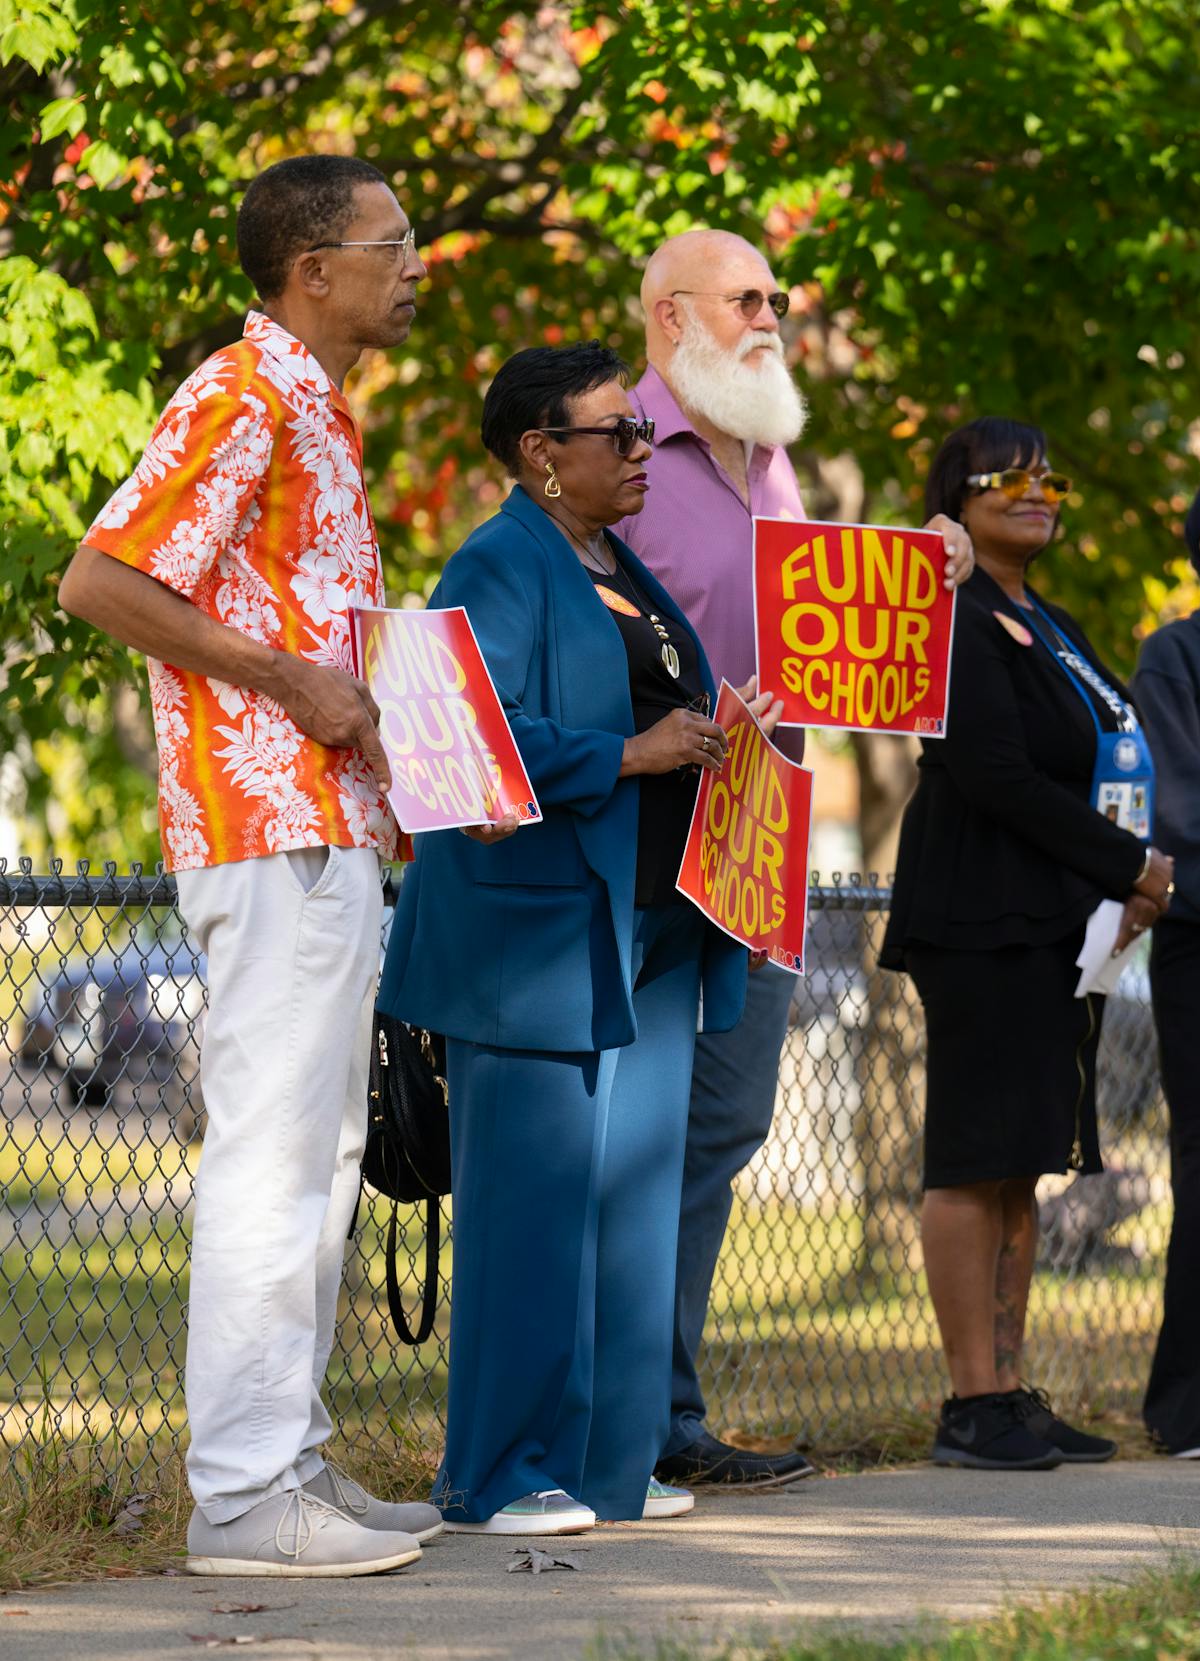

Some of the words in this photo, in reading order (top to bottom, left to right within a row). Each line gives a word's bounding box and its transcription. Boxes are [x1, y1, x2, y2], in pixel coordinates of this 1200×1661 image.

[780, 529, 938, 610] FUND
[364, 614, 467, 697] FUND
[780, 602, 931, 664] OUR
[780, 657, 931, 727] SCHOOLS
[913, 717, 944, 734] AROS
[379, 697, 489, 756] OUR
[392, 753, 502, 820] SCHOOLS
[708, 781, 785, 892] OUR
[701, 831, 787, 938] SCHOOLS
[771, 943, 802, 970] AROS
